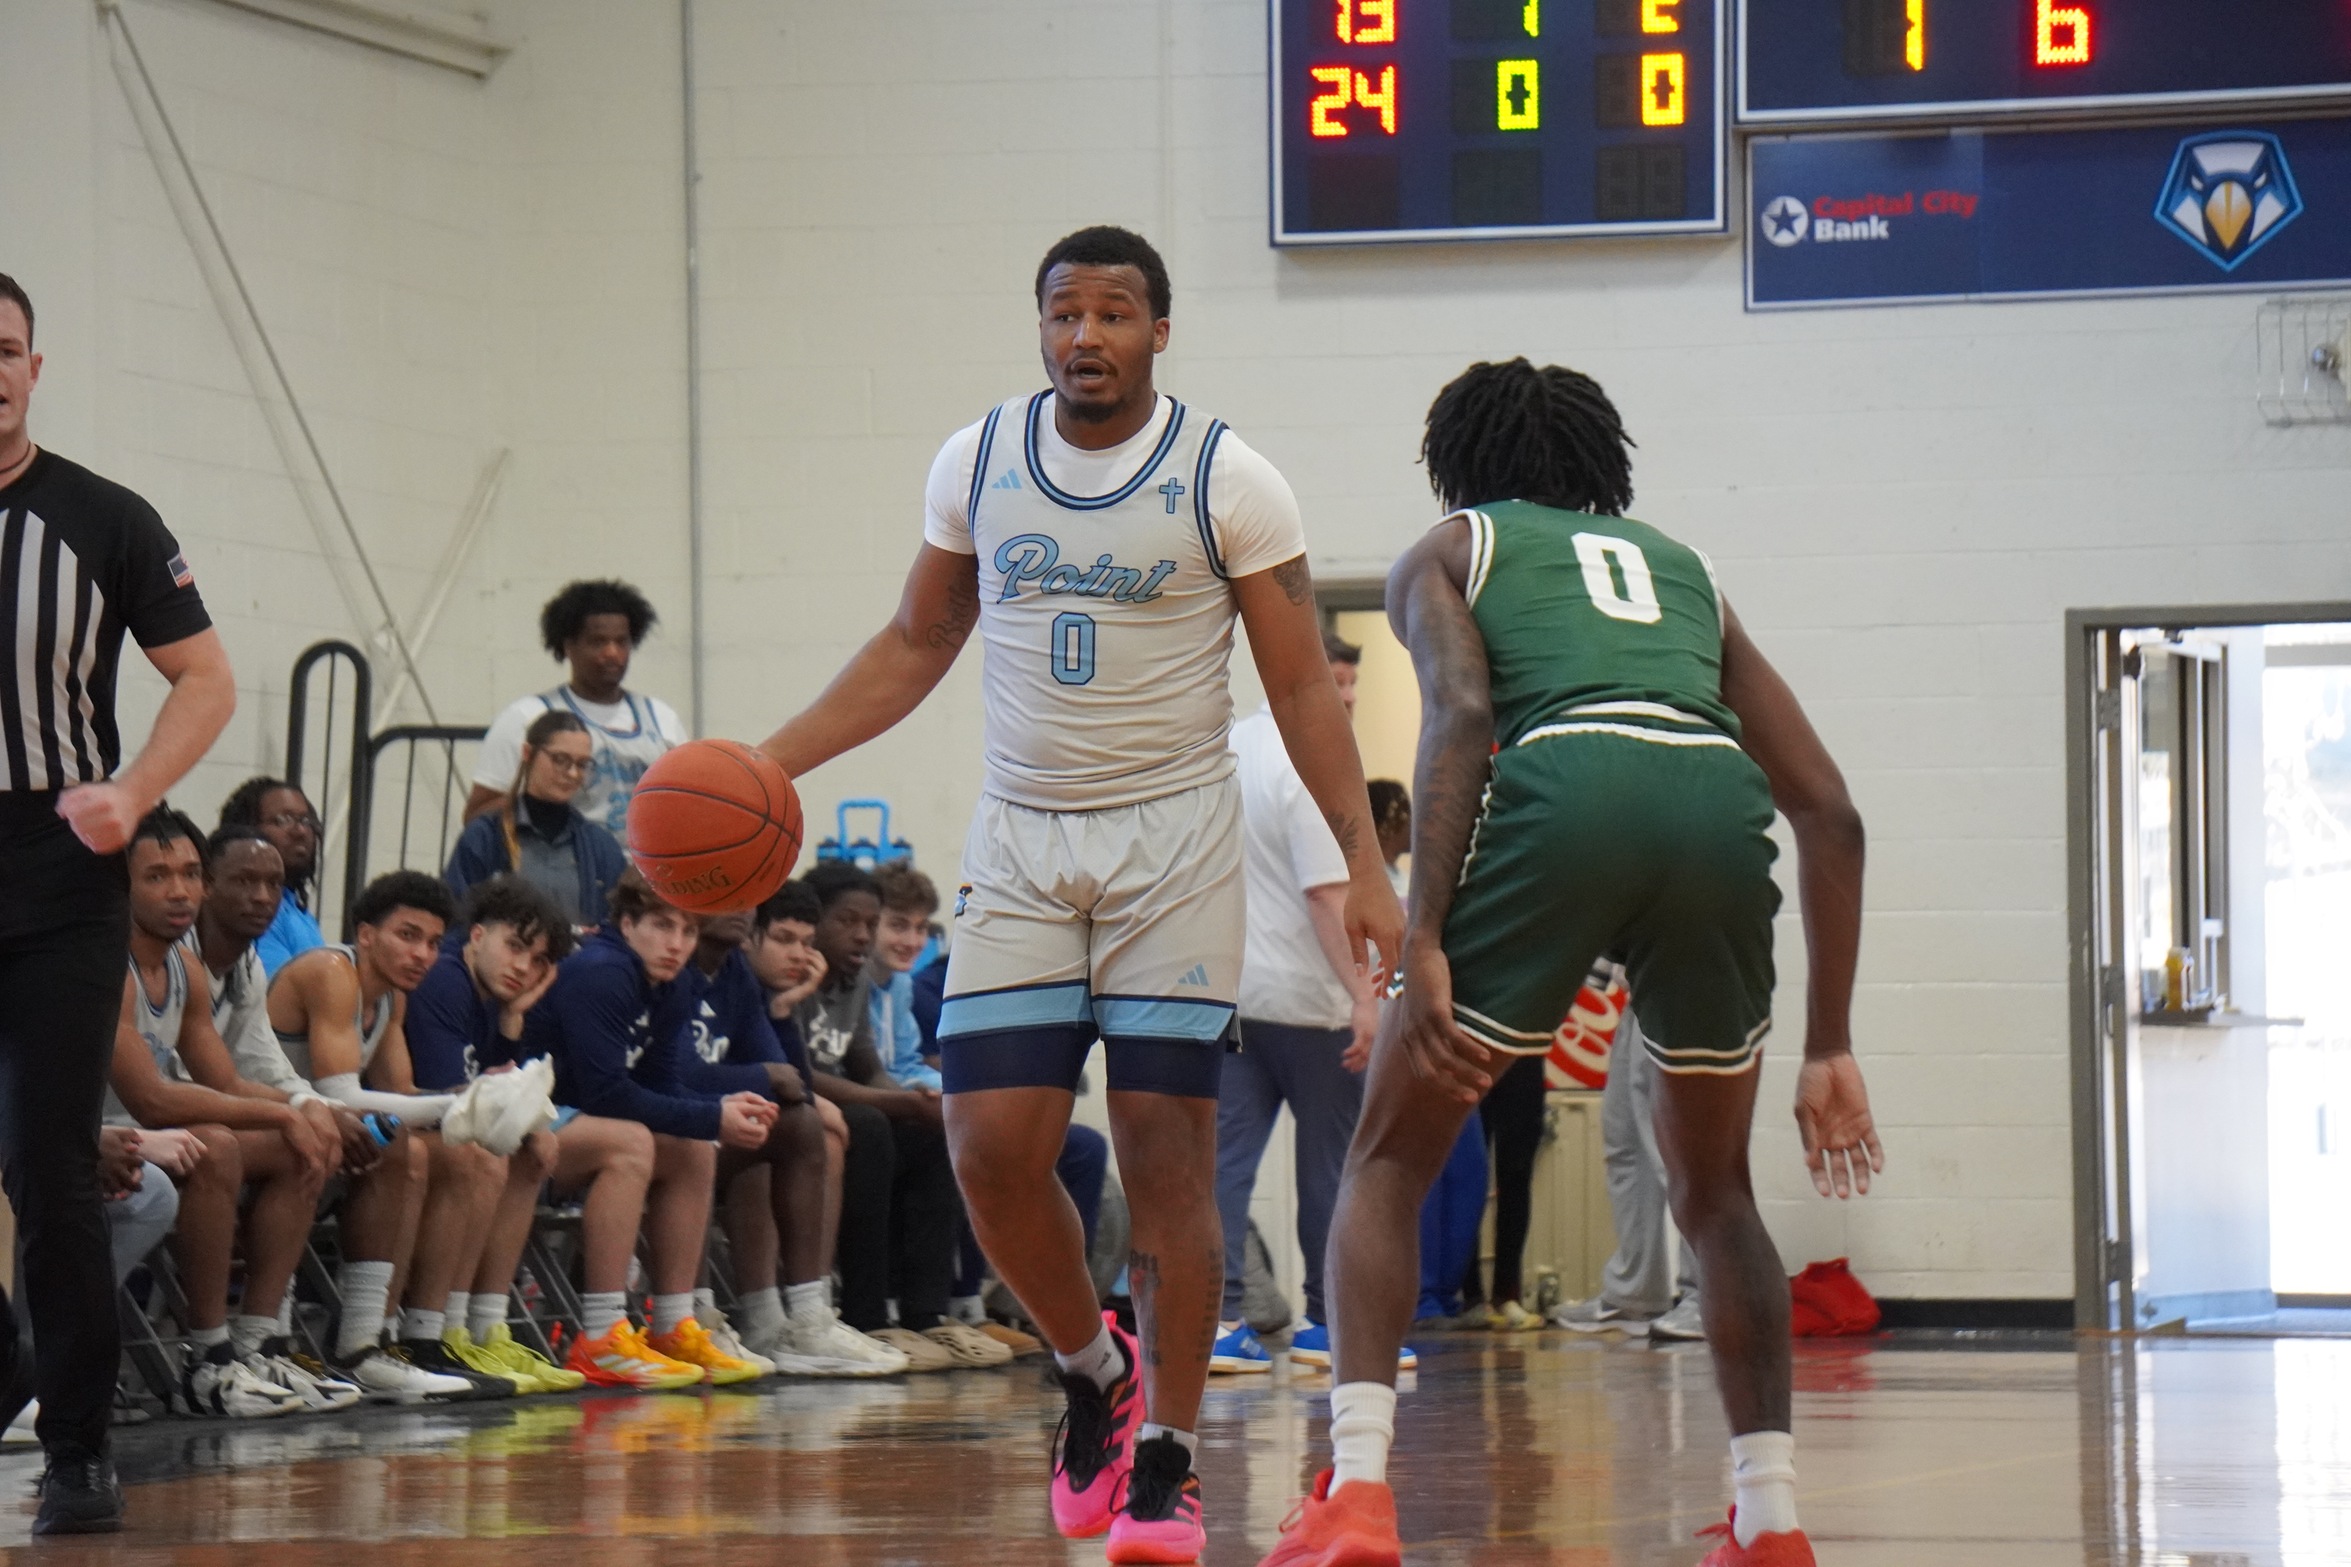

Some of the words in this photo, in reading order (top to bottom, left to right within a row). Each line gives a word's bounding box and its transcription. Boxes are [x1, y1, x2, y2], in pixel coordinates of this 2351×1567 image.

[2037, 0, 2089, 65] 6
[1310, 66, 1395, 136] 24
[1498, 60, 1538, 130] 0
[1641, 54, 1685, 126] 0
[1812, 191, 1914, 222] Capital
[1922, 190, 1978, 219] City
[1814, 214, 1889, 243] Bank
[994, 533, 1178, 605] Point
[1571, 531, 1663, 625] 0
[1051, 612, 1096, 686] 0
